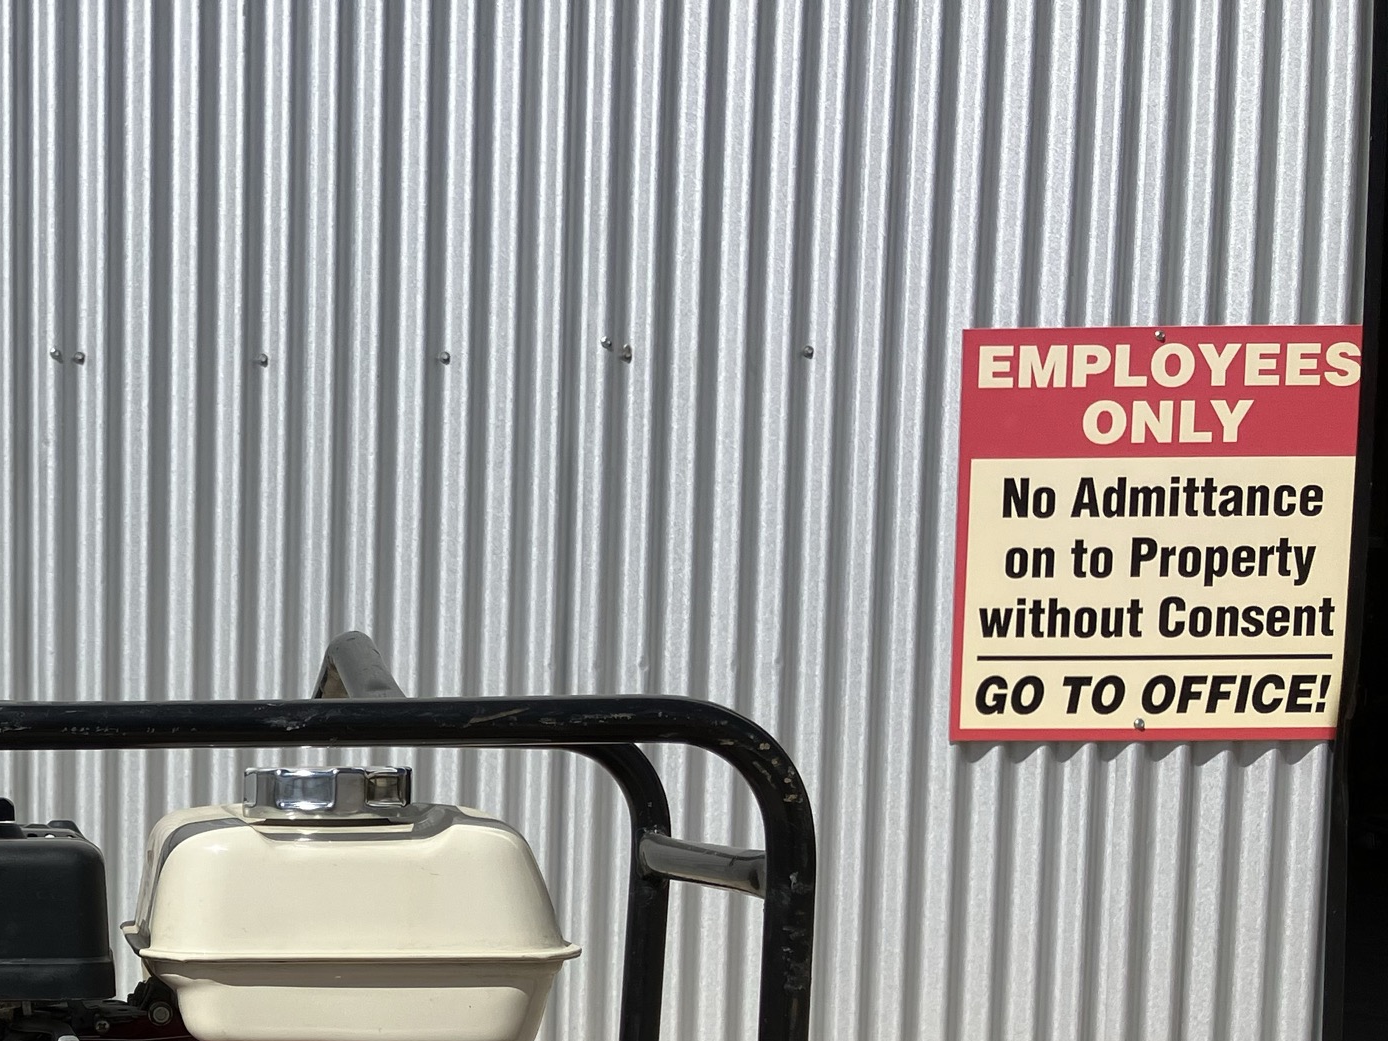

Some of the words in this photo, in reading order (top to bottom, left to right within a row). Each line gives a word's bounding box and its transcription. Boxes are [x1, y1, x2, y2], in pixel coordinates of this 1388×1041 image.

[977, 341, 1362, 389] EMPLOYEES
[1082, 399, 1254, 445] ONLY
[1002, 477, 1056, 518] No
[1070, 476, 1324, 518] Admittance
[1004, 545, 1055, 579] on
[1071, 538, 1113, 579] to
[1130, 537, 1317, 587] Property
[978, 598, 1143, 639] without
[1158, 596, 1336, 638] Consent
[975, 675, 1045, 716] GO
[1062, 675, 1126, 715] TO
[1140, 674, 1332, 715] OFFICE!
